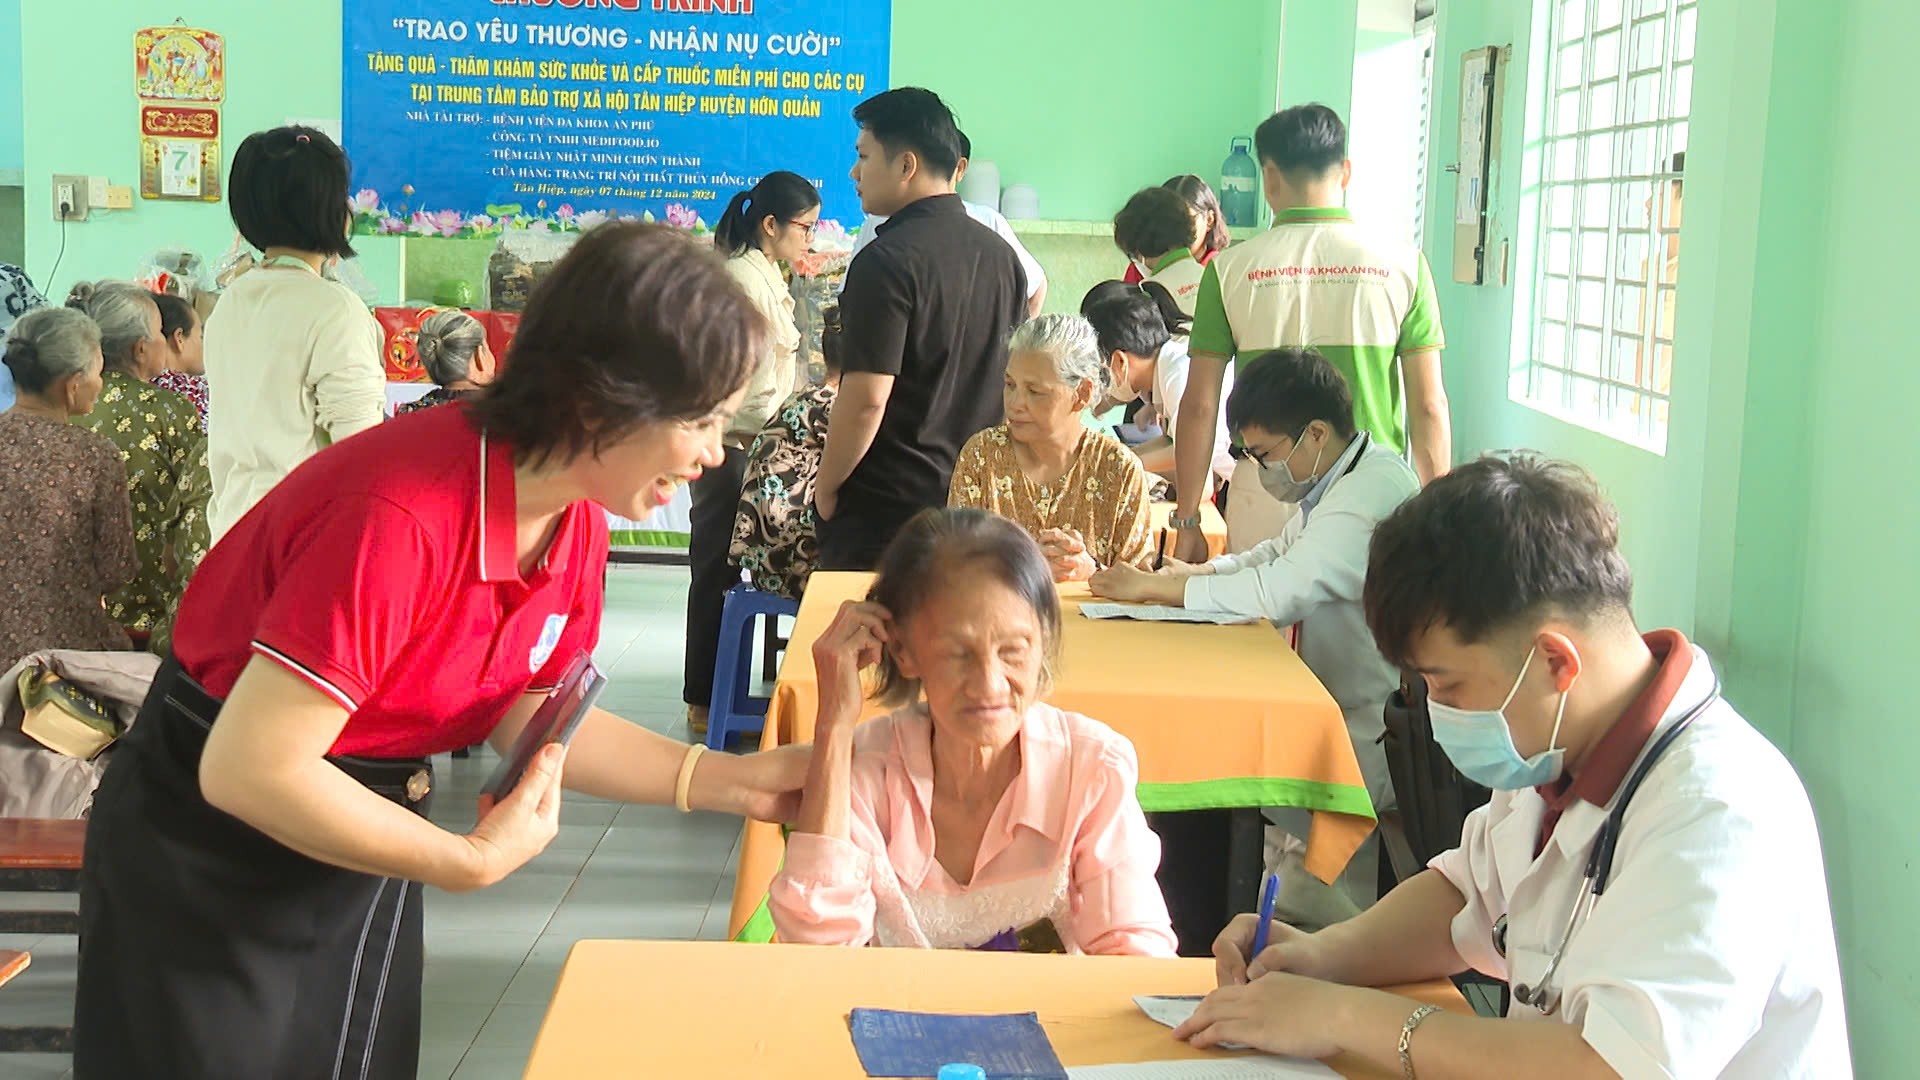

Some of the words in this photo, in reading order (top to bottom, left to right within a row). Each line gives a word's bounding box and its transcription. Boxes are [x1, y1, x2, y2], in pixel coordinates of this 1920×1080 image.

[476, 17, 518, 45] YÊU
[526, 23, 629, 49] THƯƠNG
[650, 25, 718, 58] NHẬN
[727, 32, 759, 60] NỤ
[367, 51, 404, 76] TẶNG
[450, 55, 490, 77] THĂM
[494, 57, 535, 79] KHÁM
[539, 58, 568, 80] SỨC
[571, 58, 608, 82] KHỎE
[611, 61, 630, 83] VÀ
[633, 59, 662, 84] CẤP
[666, 61, 711, 86] THUỐC
[714, 64, 751, 88] MIỄN
[755, 67, 778, 89] PHÍ
[782, 71, 811, 90] CHO
[814, 70, 843, 91] CÁC
[846, 74, 866, 96] CỤ
[411, 84, 433, 106] TẠI
[437, 85, 482, 105] TRUNG
[486, 83, 517, 106] TÂM
[520, 83, 549, 107] BẢO
[552, 89, 580, 112] TRỢ
[583, 88, 602, 110] XÃ
[606, 89, 629, 115] HỘI
[633, 90, 661, 112] TÂN
[664, 91, 696, 117] HIỆP
[700, 93, 746, 119] HUYỆN
[750, 96, 779, 117] HỚN
[782, 94, 821, 119] QUẢN
[406, 111, 430, 123] NHÀ
[433, 111, 453, 124] TÀI
[493, 113, 524, 128] BỆNH
[576, 118, 609, 129] KHOA
[613, 119, 628, 130] AN
[493, 130, 526, 143] CÔNG
[528, 133, 544, 144] TY
[172, 151, 189, 171] 7
[591, 152, 622, 164] MINH
[661, 152, 701, 167] THÀNH
[519, 165, 552, 179] HÀNG
[555, 169, 594, 180] TRANG
[597, 168, 617, 181] TRÍ
[619, 170, 641, 184] NỘI
[643, 168, 674, 183] THẤT
[569, 187, 596, 197] ngày
[599, 187, 611, 196] 07
[650, 188, 663, 198] 12
[1318, 265, 1349, 275] KHOA
[1350, 265, 1366, 274] AN
